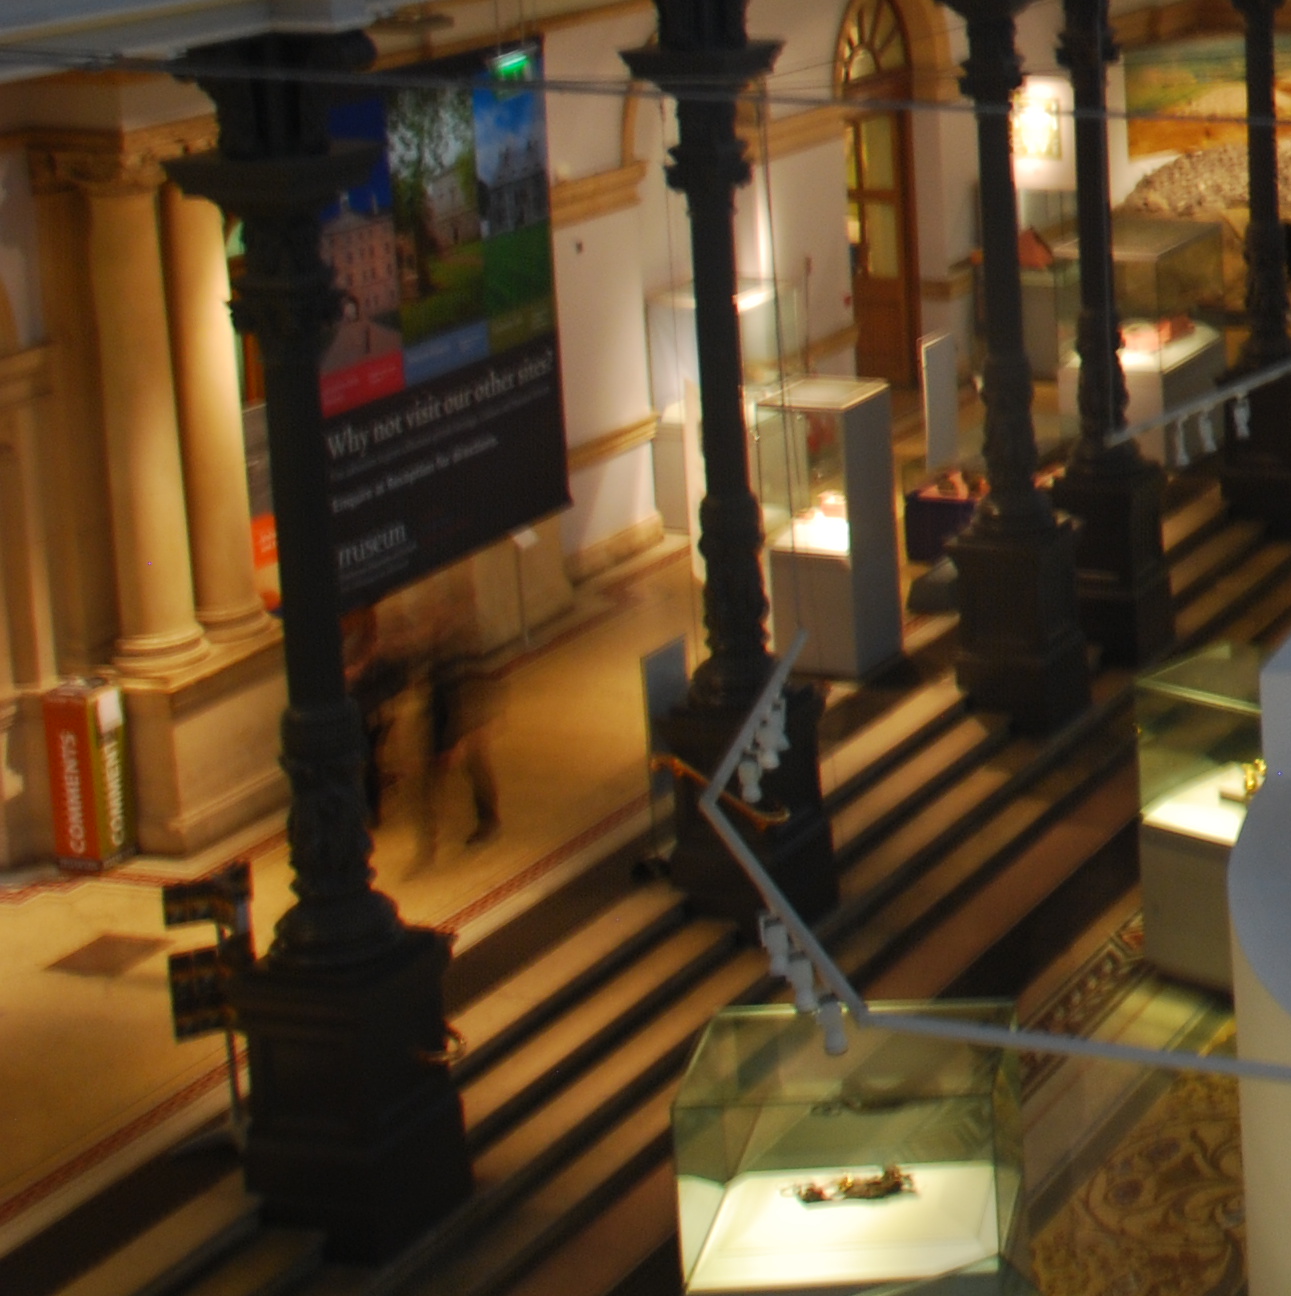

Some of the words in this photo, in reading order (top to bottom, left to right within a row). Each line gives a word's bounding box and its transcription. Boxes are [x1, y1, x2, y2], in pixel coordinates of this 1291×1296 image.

[327, 424, 369, 459] Why
[373, 414, 403, 443] not
[405, 395, 442, 428] visit
[443, 391, 473, 415] our
[474, 371, 515, 402] other
[338, 524, 407, 567] museum
[60, 730, 86, 854] COMMENTS
